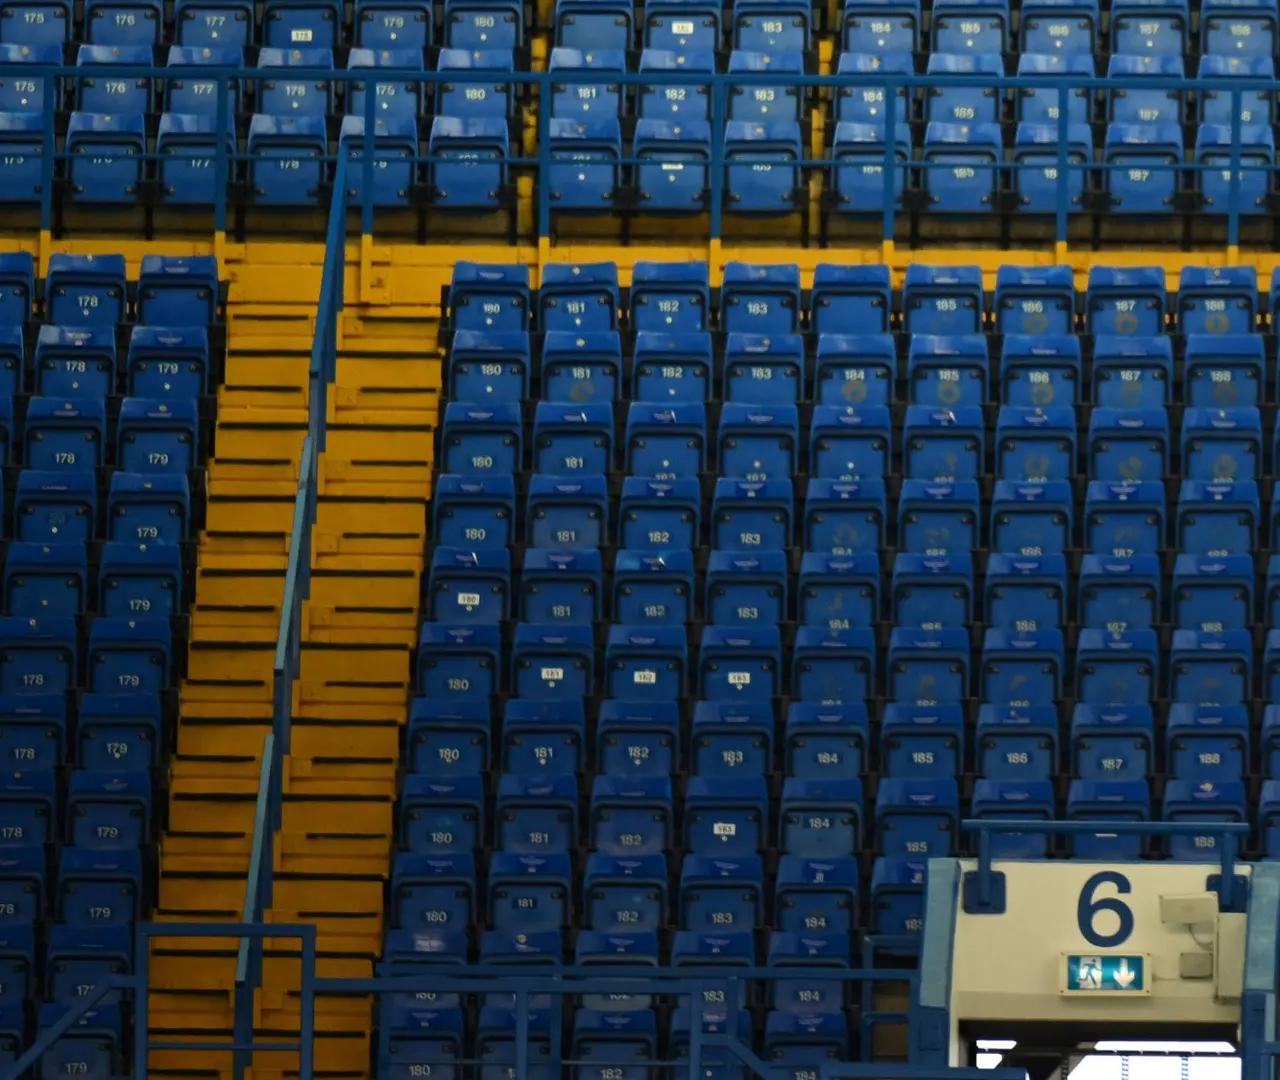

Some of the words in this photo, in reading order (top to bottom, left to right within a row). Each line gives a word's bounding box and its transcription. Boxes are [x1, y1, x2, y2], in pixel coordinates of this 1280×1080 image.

[24, 13, 44, 24] 175
[116, 15, 135, 25] 176
[206, 16, 226, 27] 177
[762, 22, 782, 32] 183
[106, 82, 125, 93] 176
[193, 84, 213, 94] 177
[578, 88, 596, 98] 181
[665, 89, 685, 100] 182
[755, 90, 774, 100] 183
[78, 296, 98, 307] 178
[659, 301, 678, 312] 182
[1116, 300, 1135, 311] 187
[483, 304, 500, 314] 180
[567, 302, 585, 313] 181
[748, 303, 768, 314] 183
[66, 361, 85, 372] 178
[158, 363, 178, 374] 179
[481, 365, 501, 375] 180
[572, 368, 590, 379] 181
[662, 367, 683, 378] 182
[752, 368, 772, 379] 183
[845, 370, 864, 381] 184
[1120, 371, 1140, 381] 187
[55, 453, 75, 464] 178
[148, 453, 168, 464] 179
[472, 457, 492, 468] 180
[565, 457, 583, 468] 181
[137, 527, 157, 538] 179
[465, 528, 485, 540] 180
[557, 531, 575, 542] 181
[649, 531, 669, 543] 182
[740, 534, 760, 544] 183
[129, 600, 150, 610] 179
[552, 606, 570, 616] 181
[737, 608, 757, 618] 183
[23, 675, 44, 685] 178
[118, 675, 139, 686] 179
[448, 679, 469, 690] 180
[13, 748, 34, 759] 178
[106, 743, 127, 755] 179
[439, 748, 459, 759] 180
[534, 747, 553, 758] 181
[628, 747, 649, 758] 182
[722, 751, 743, 762] 183
[817, 753, 838, 764] 184
[912, 752, 933, 764] 185
[1007, 752, 1028, 764] 186
[1199, 753, 1220, 764] 188
[1102, 759, 1123, 770] 187
[809, 818, 829, 828] 184
[1, 827, 22, 837] 178
[97, 827, 118, 837] 179
[529, 832, 548, 843] 181
[431, 833, 452, 843] 180
[620, 834, 641, 845] 182
[906, 841, 927, 852] 185
[518, 899, 533, 908] 181
[1076, 871, 1135, 947] 6
[89, 907, 110, 918] 179
[425, 911, 447, 922] 180
[617, 911, 638, 922] 182
[712, 913, 733, 924] 183
[805, 918, 826, 928] 184
[77, 986, 94, 995] 17
[798, 991, 819, 1001] 184
[703, 991, 724, 1002] 183
[67, 1063, 87, 1074] 179
[409, 1065, 430, 1076] 180
[600, 1069, 622, 1080] 182
